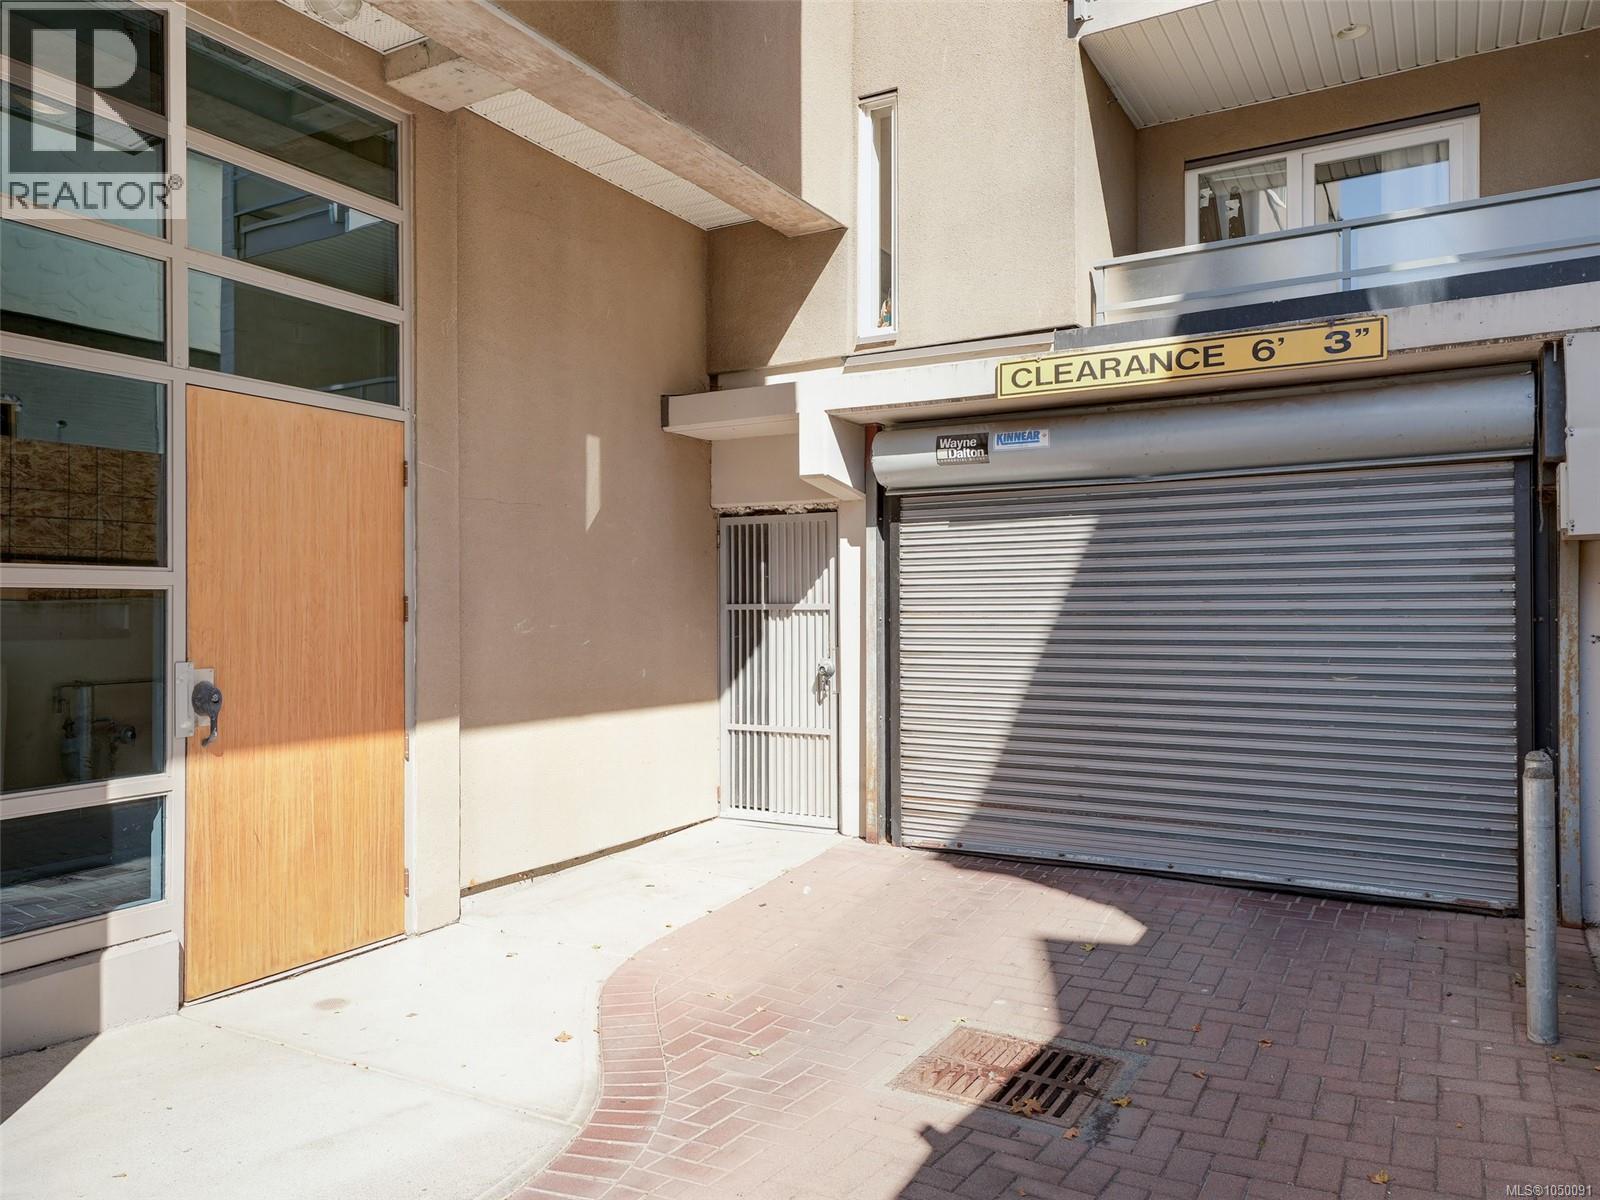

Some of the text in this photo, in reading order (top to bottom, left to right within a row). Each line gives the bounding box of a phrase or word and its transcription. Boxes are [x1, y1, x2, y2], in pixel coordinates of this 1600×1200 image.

[1010, 343, 1225, 388] CLEARANCE
[940, 438, 977, 449] Wayne
[996, 430, 1040, 446] KINNEAR
